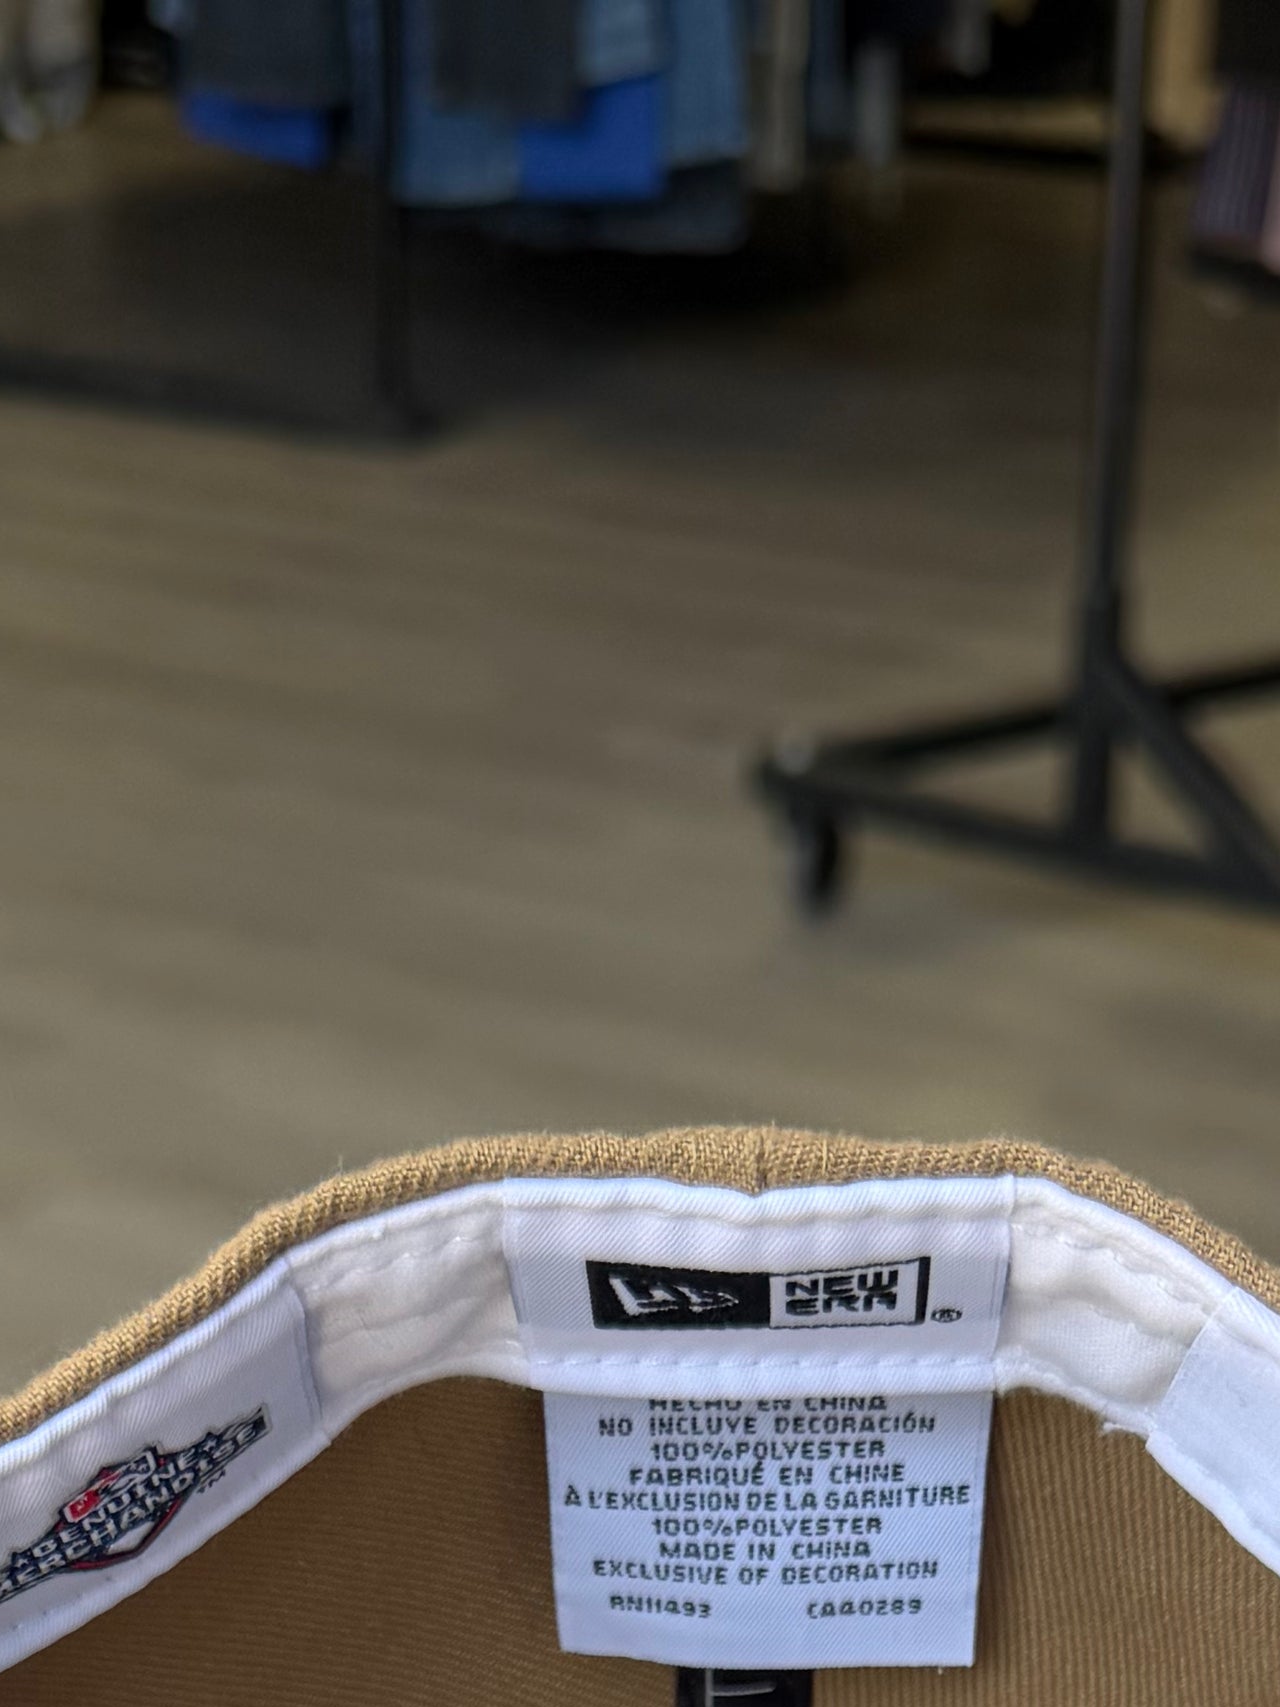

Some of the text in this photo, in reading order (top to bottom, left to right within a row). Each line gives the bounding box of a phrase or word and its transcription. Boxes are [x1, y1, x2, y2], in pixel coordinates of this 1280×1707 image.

[786, 1270, 899, 1297] NEW
[786, 1291, 897, 1316] ERA
[804, 1396, 888, 1412] CHINA
[599, 1411, 935, 1436] NO INCLUYE DECORACIÓN
[629, 1460, 905, 1487] FABRIQUÉ EN CHINE
[32, 1448, 197, 1558] GENUINE
[564, 1484, 971, 1511] À L'EXCLUSION DE LA GARNITURE
[659, 1541, 872, 1561] MADE IN CHINA
[593, 1560, 938, 1585] EXCLUSIVE OF DECORATION
